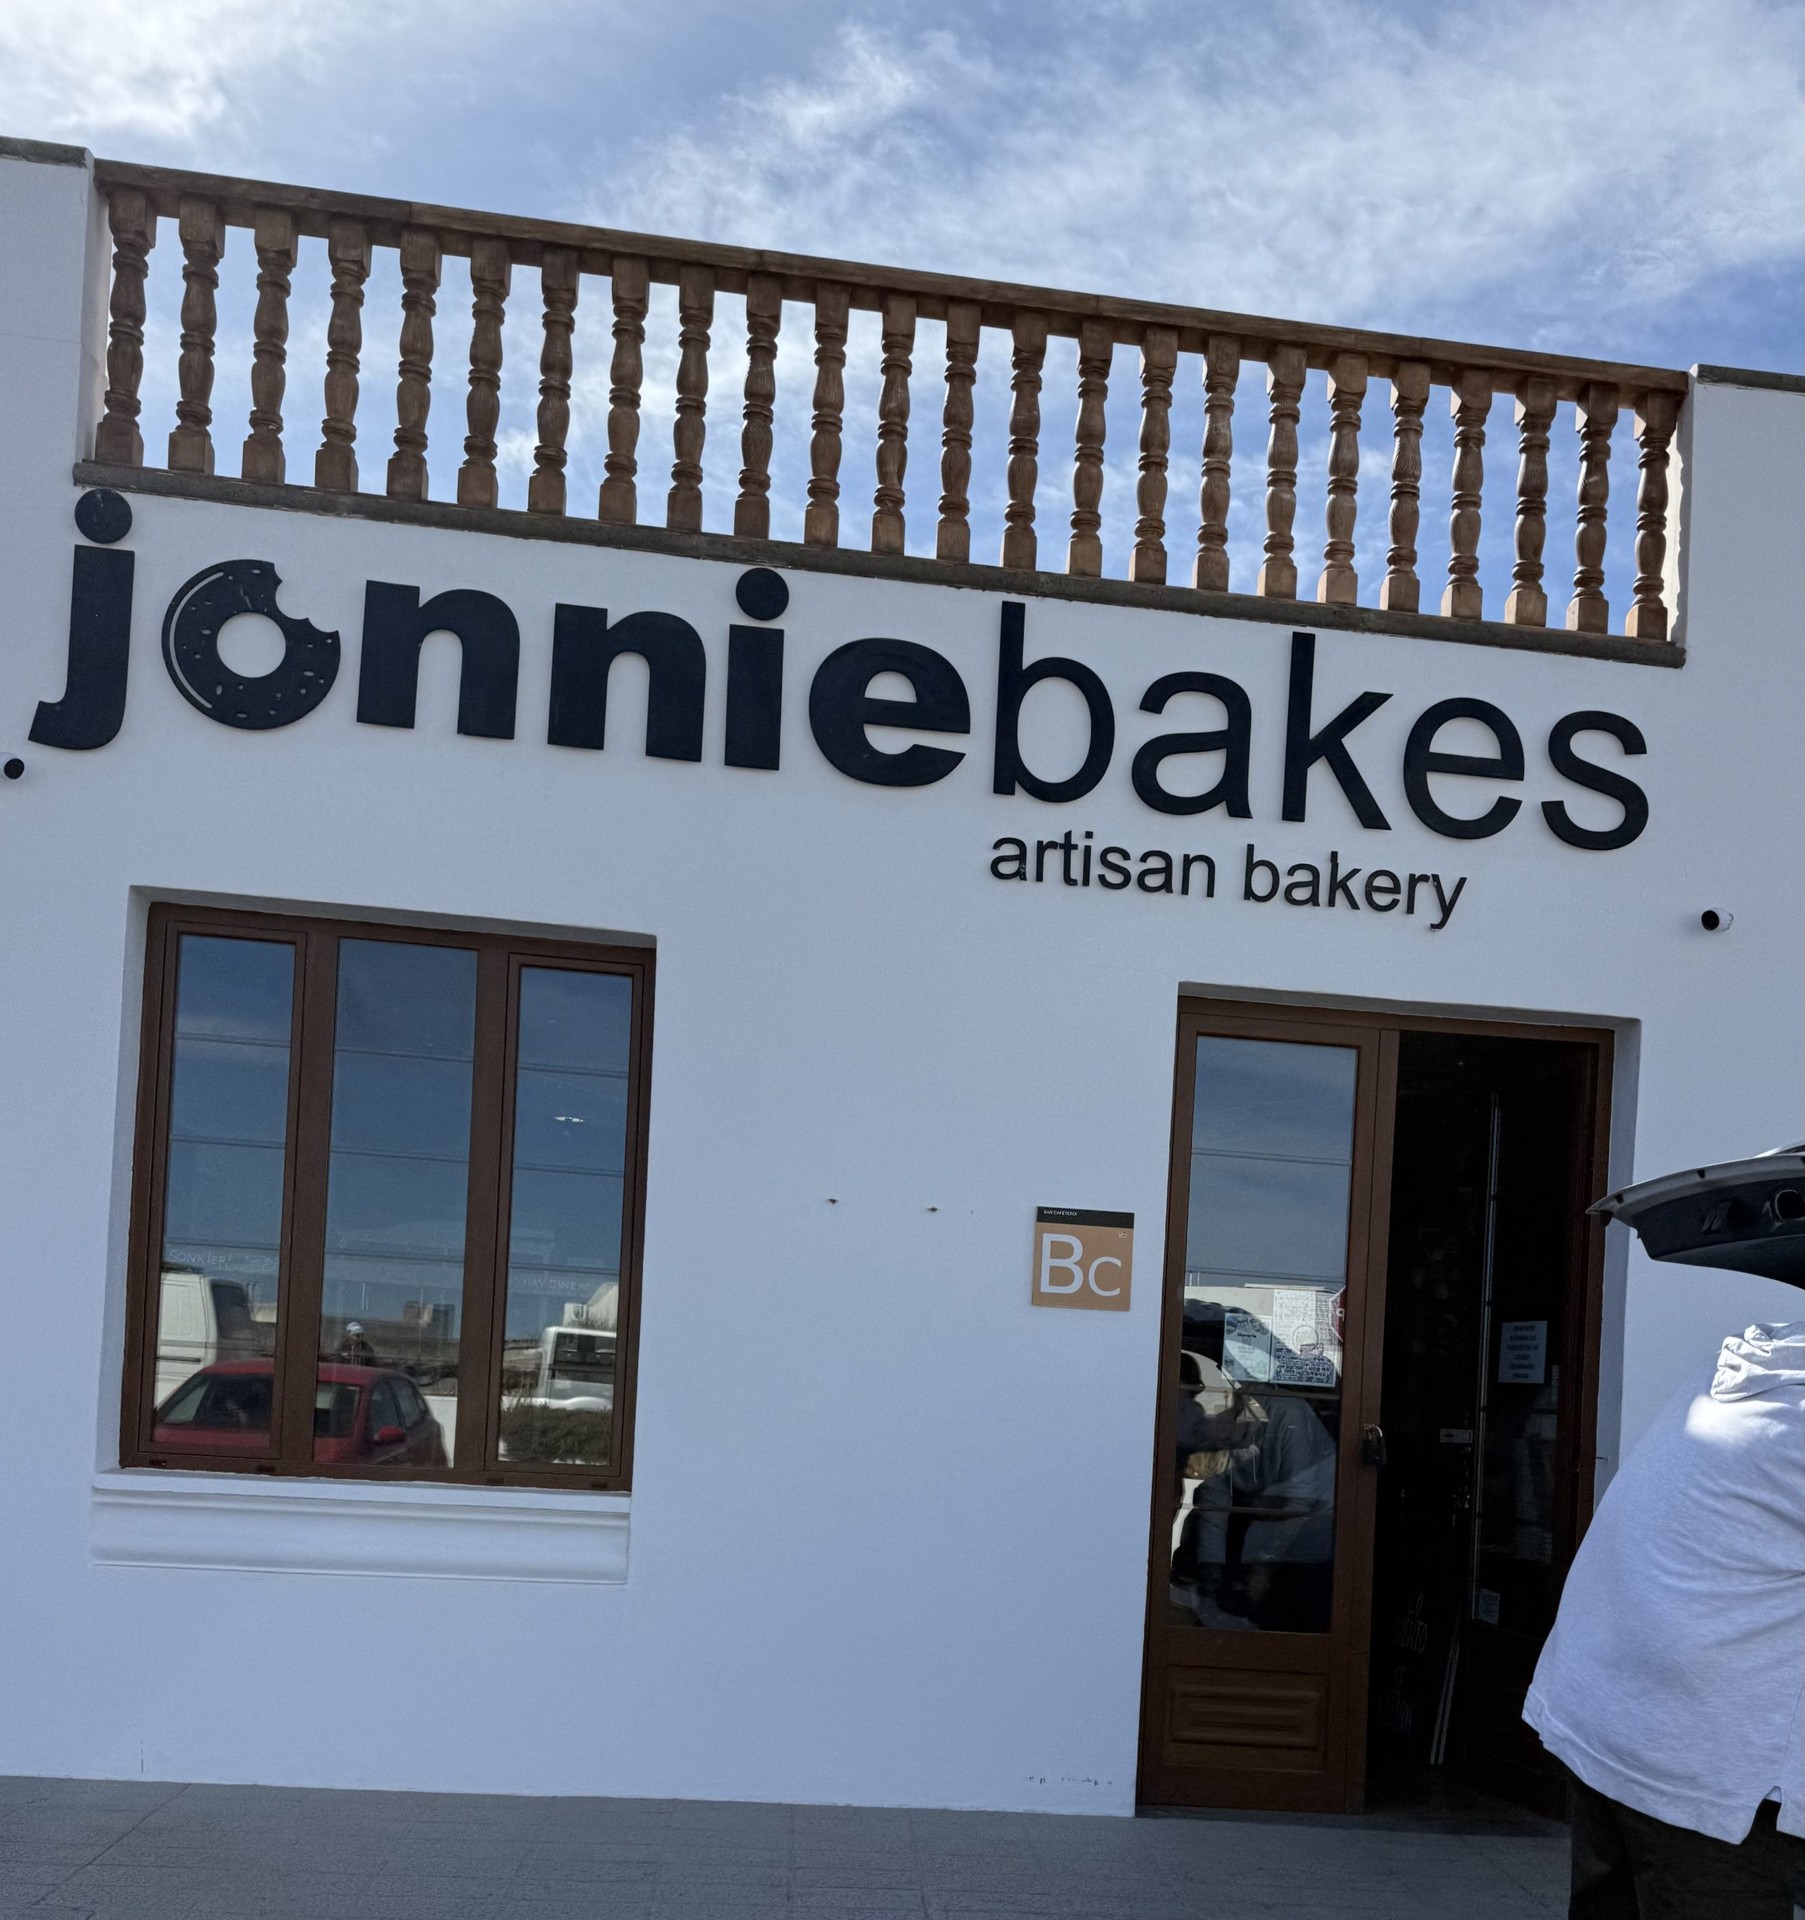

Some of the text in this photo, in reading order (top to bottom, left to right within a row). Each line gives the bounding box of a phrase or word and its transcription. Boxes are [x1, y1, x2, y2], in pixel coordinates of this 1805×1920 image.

[990, 830, 1467, 931] artisan bakery
[1040, 1233, 1121, 1297] Bc
